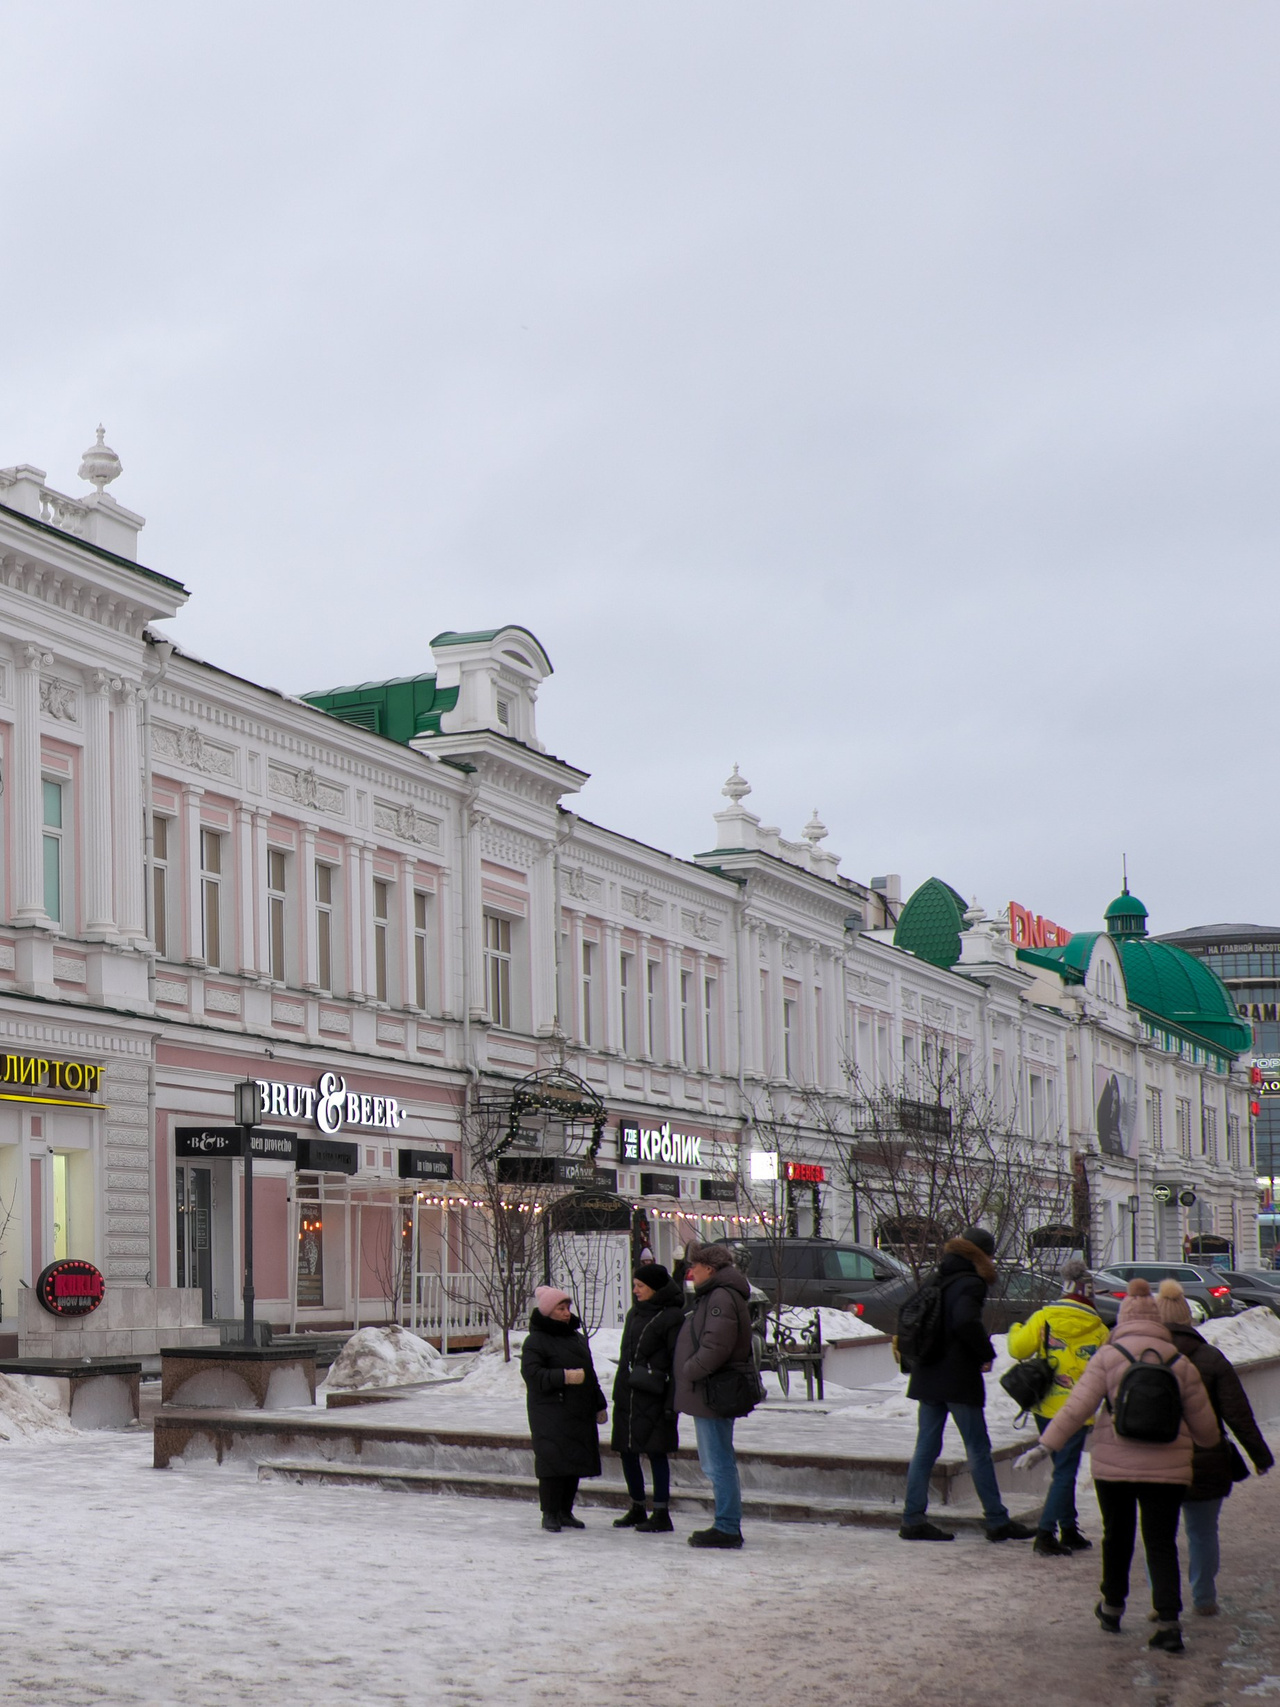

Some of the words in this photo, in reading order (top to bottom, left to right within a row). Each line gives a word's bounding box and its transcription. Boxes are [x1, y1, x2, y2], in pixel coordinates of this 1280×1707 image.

[255, 1080, 317, 1119] BRUT
[346, 1092, 401, 1128] BEER
[623, 1128, 638, 1143] ГДЕ
[264, 1138, 292, 1153] provecho
[625, 1144, 638, 1158] ЖЕ
[640, 1121, 702, 1166] КРОЛИК
